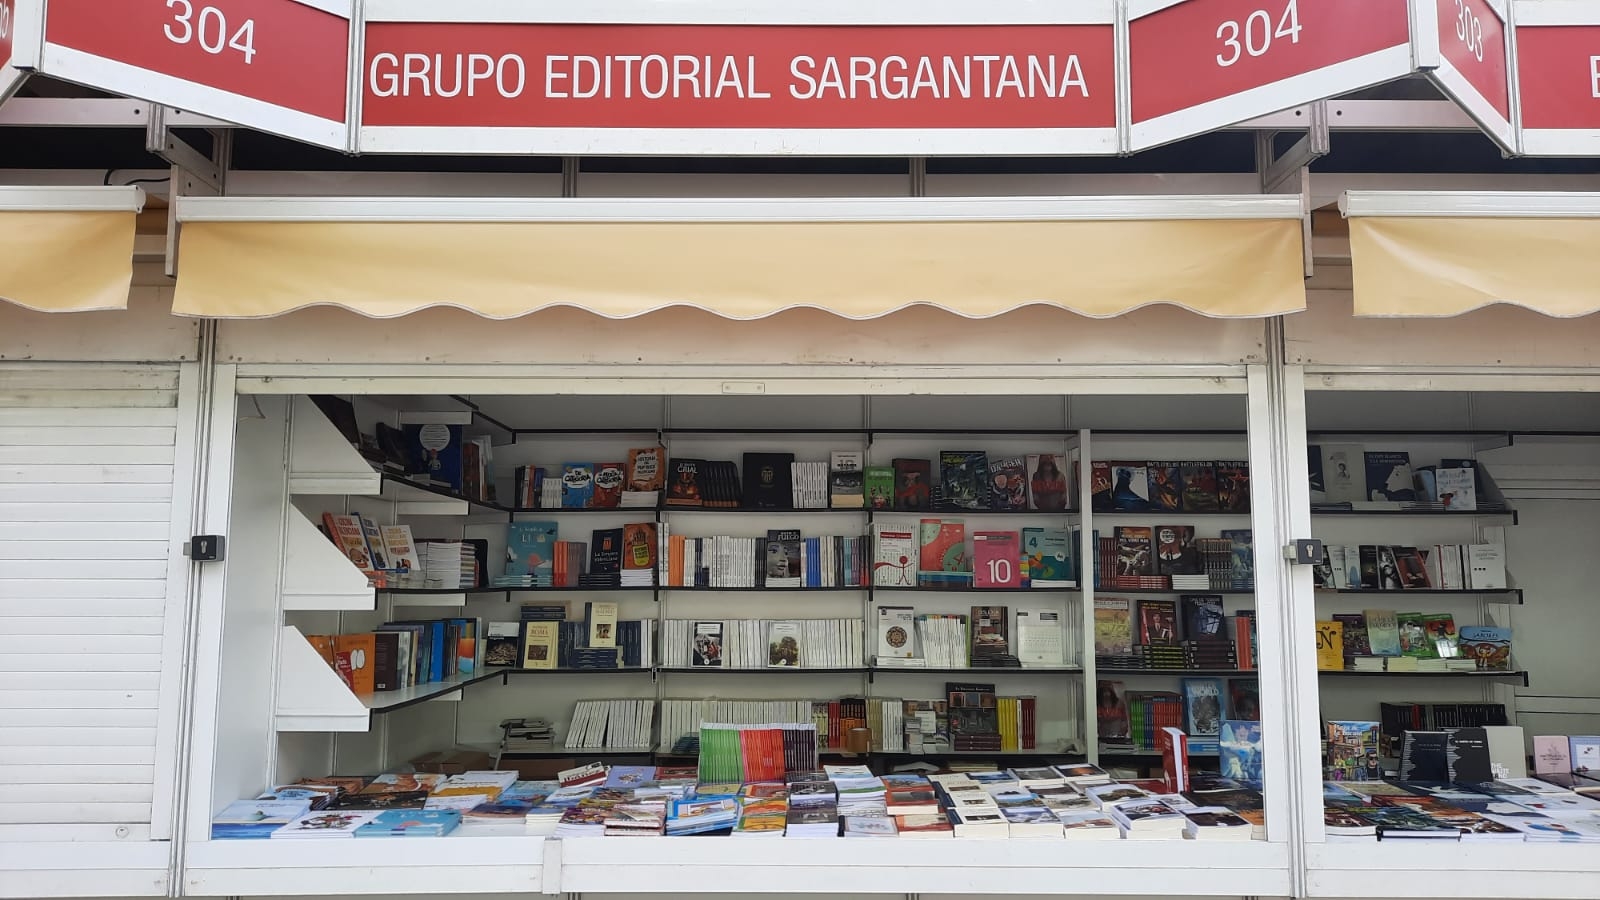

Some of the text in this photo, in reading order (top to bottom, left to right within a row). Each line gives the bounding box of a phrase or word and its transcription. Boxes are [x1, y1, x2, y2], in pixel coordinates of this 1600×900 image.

[163, 0, 257, 65] 304
[1216, 0, 1303, 67] 304
[1455, 0, 1483, 62] 303
[369, 53, 1091, 100] GRUPO EDITORIAL SARGANTANA
[986, 559, 1011, 583] 10
[1317, 626, 1336, 649] Ñ
